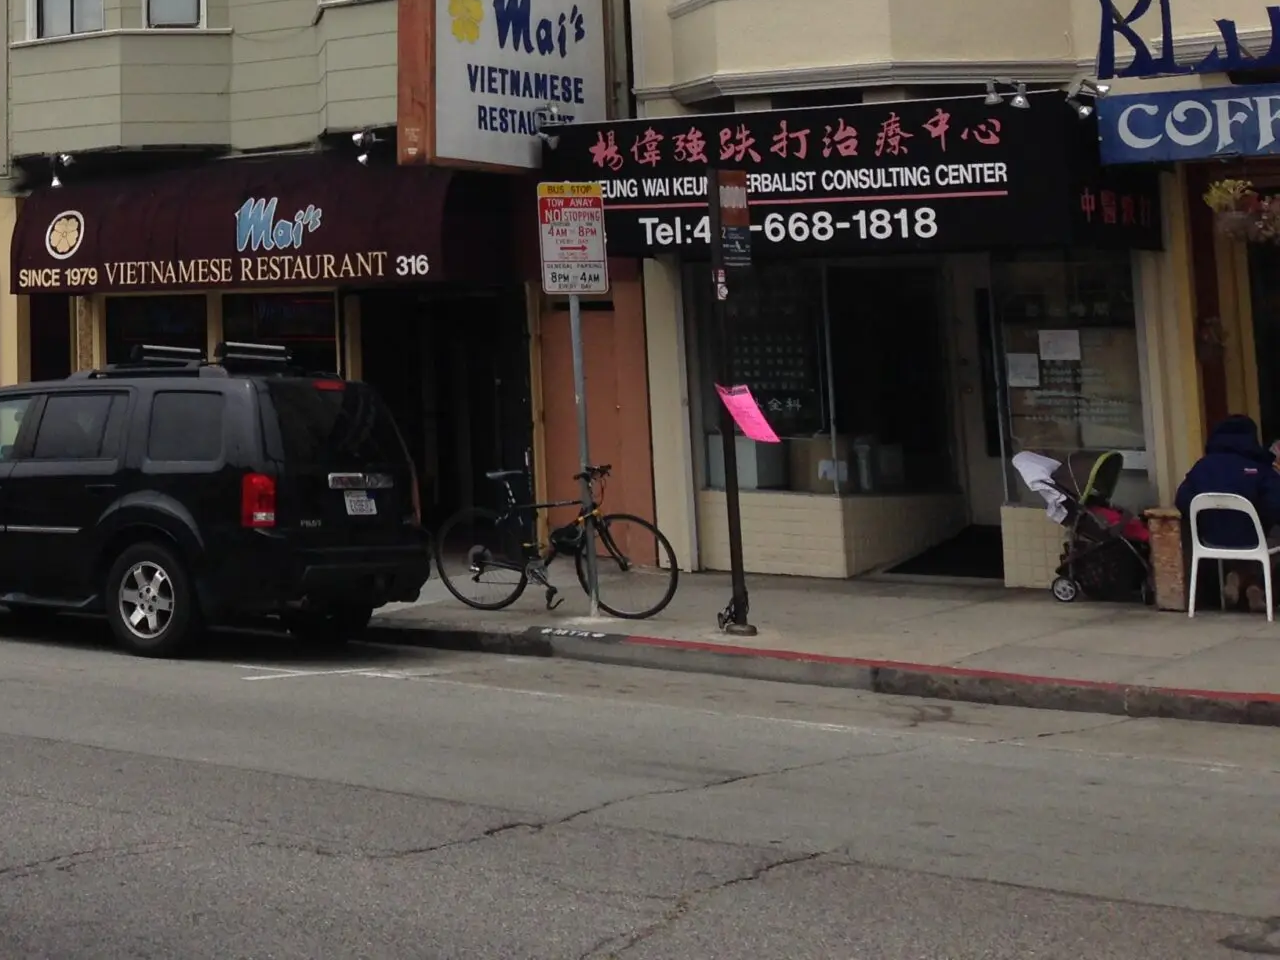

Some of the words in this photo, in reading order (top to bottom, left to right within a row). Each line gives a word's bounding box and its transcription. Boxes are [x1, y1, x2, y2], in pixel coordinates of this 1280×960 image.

[467, 63, 584, 104] VIETNAMESE
[477, 104, 576, 136] RESTAU
[589, 108, 1002, 171] 楊偉強跌打治療中心
[547, 185, 564, 194] BUS
[570, 185, 592, 194] STOP
[592, 178, 638, 198] EUNG
[642, 177, 669, 197] WAI
[673, 176, 709, 196] KEUN
[746, 171, 817, 193] ERBALIST
[821, 165, 930, 191] CONSULTING
[935, 162, 1008, 187] CENTER
[545, 210, 560, 222] NO
[563, 211, 600, 222] STOPPING
[547, 198, 564, 207] TOW
[570, 198, 593, 207] AWAY
[235, 196, 322, 252] Mai's
[638, 207, 938, 246] Tel:4-668-1818
[19, 269, 60, 287] SINCE
[64, 268, 98, 286] 1979
[104, 258, 232, 284] VIETNAMESE
[240, 251, 387, 281] RESTAURANT
[396, 254, 429, 275] 316
